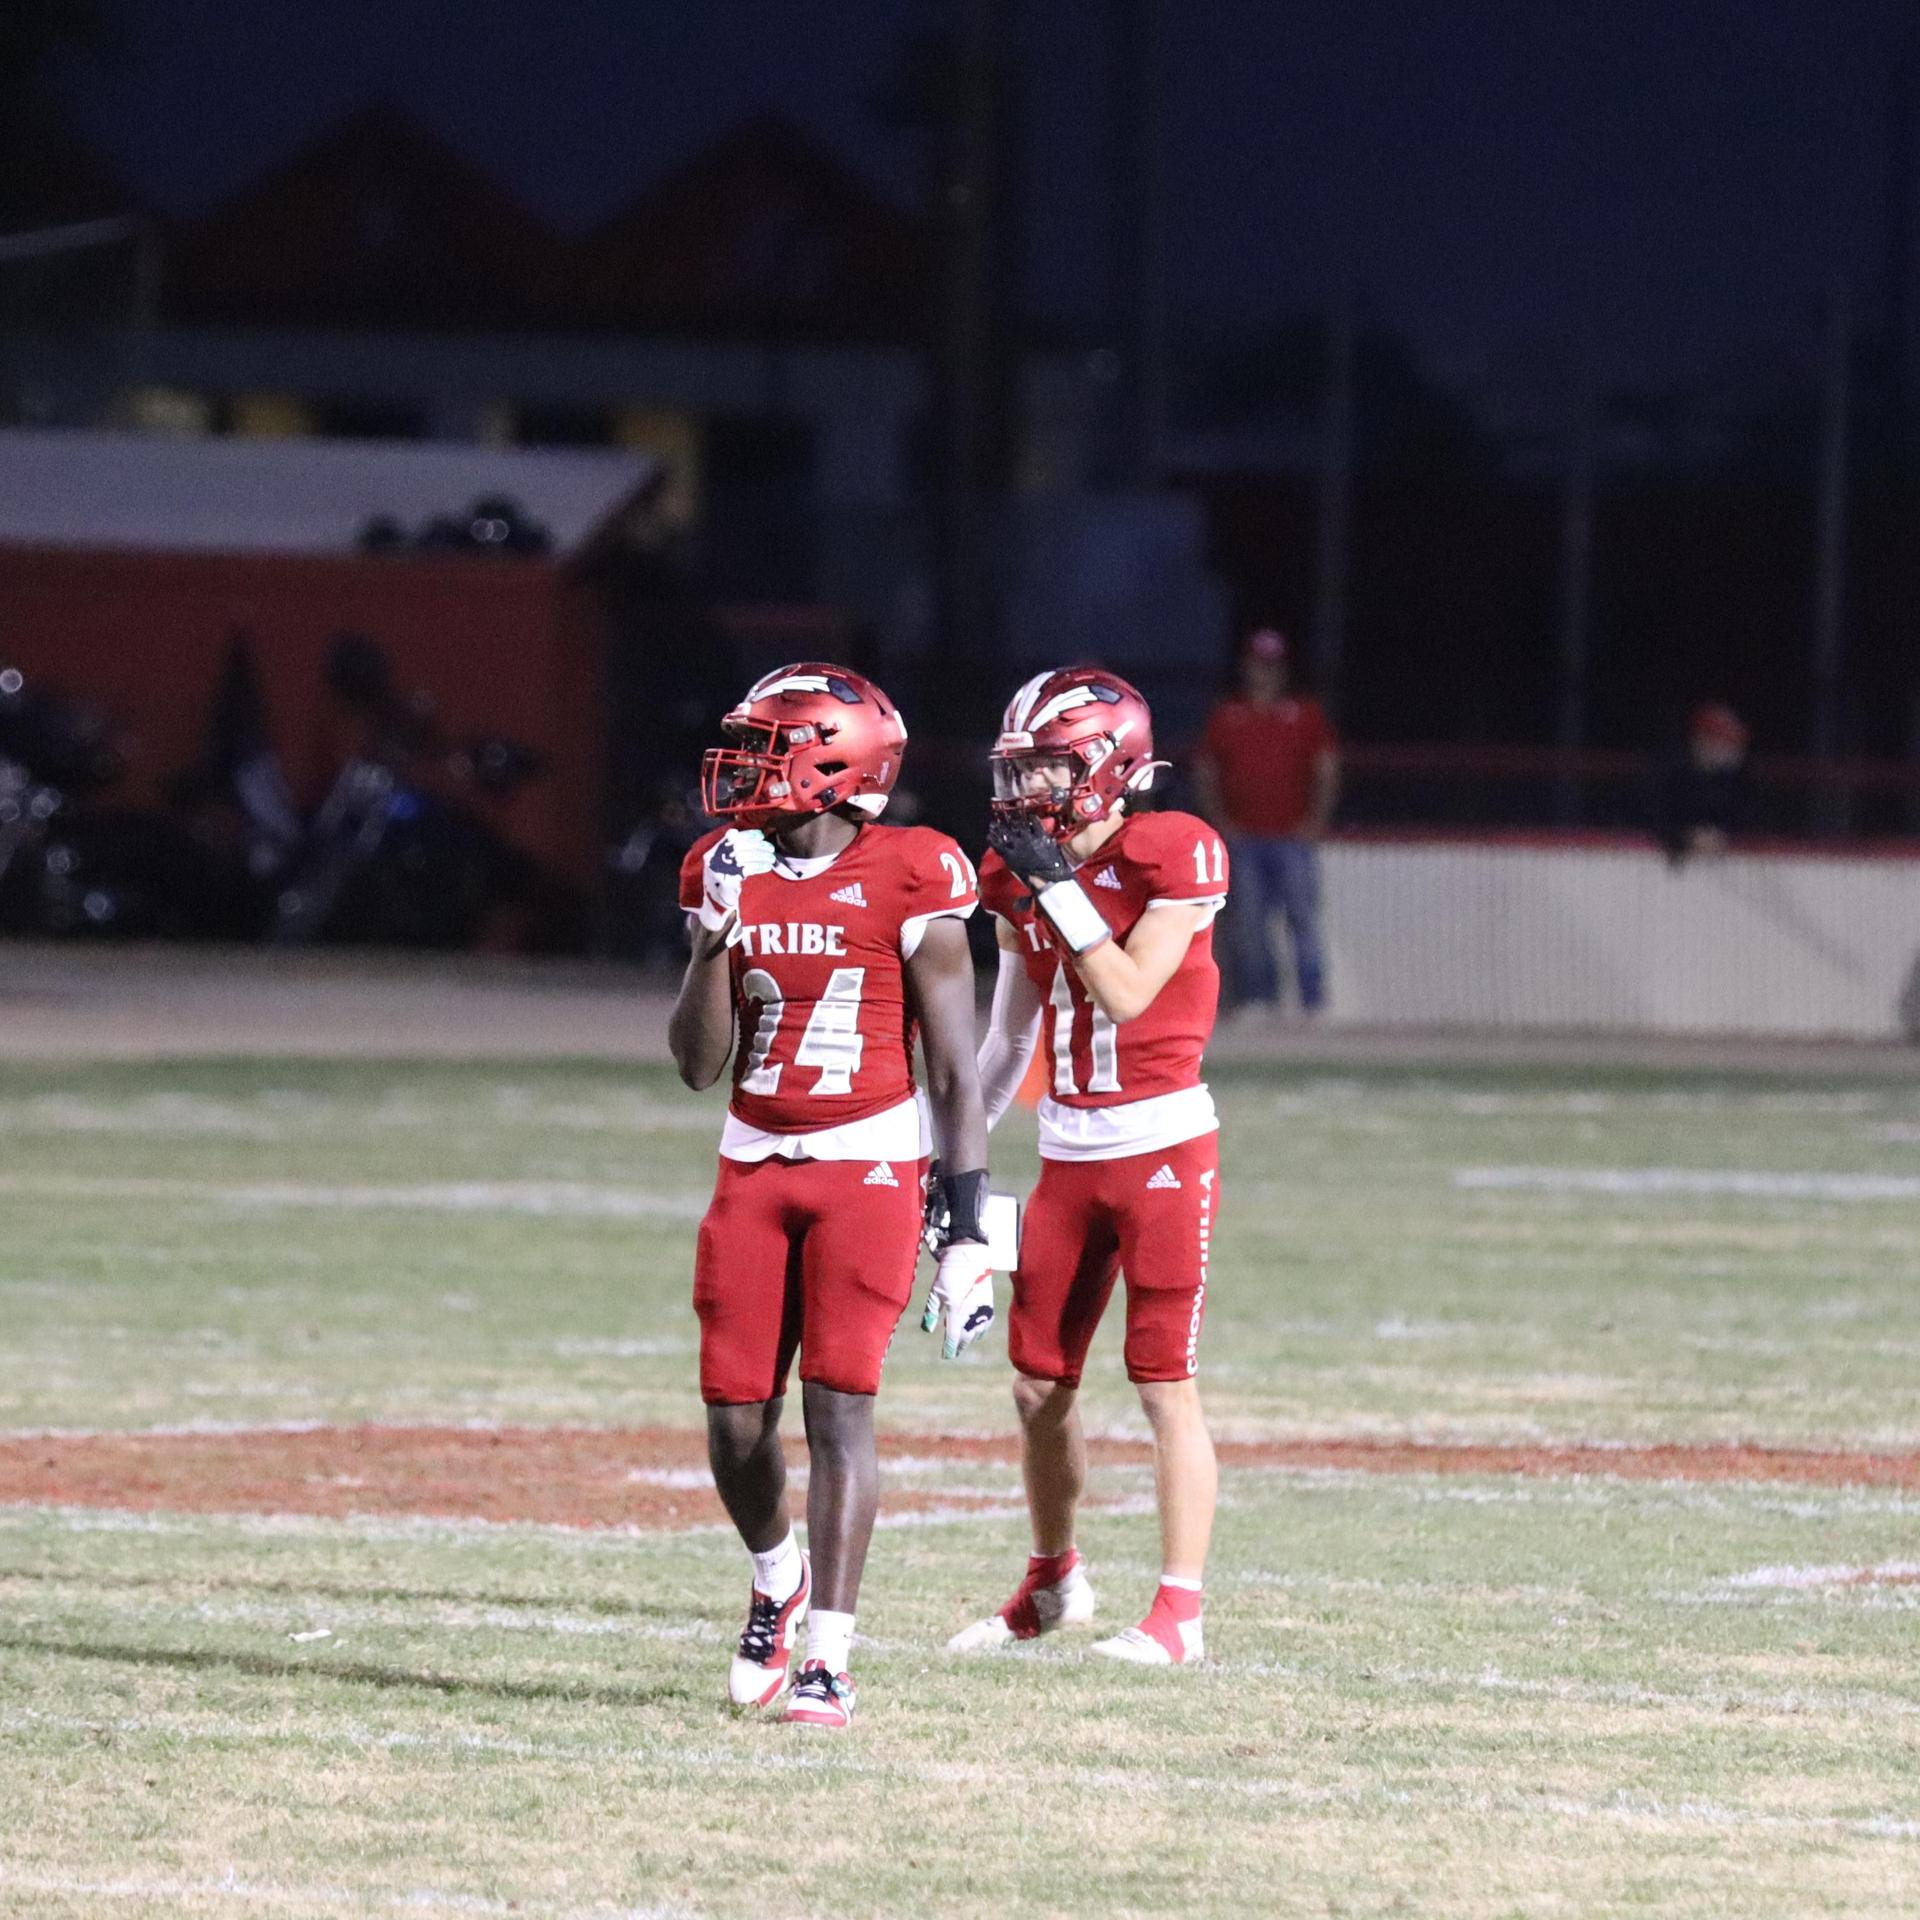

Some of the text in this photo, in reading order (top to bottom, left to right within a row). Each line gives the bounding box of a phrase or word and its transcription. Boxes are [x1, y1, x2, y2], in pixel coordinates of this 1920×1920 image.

[1193, 839, 1223, 884] 11
[829, 892, 867, 908] adidas
[741, 922, 847, 956] TRIBE
[739, 967, 866, 1095] 24
[1049, 958, 1122, 1096] 11
[863, 1176, 899, 1188] adidas
